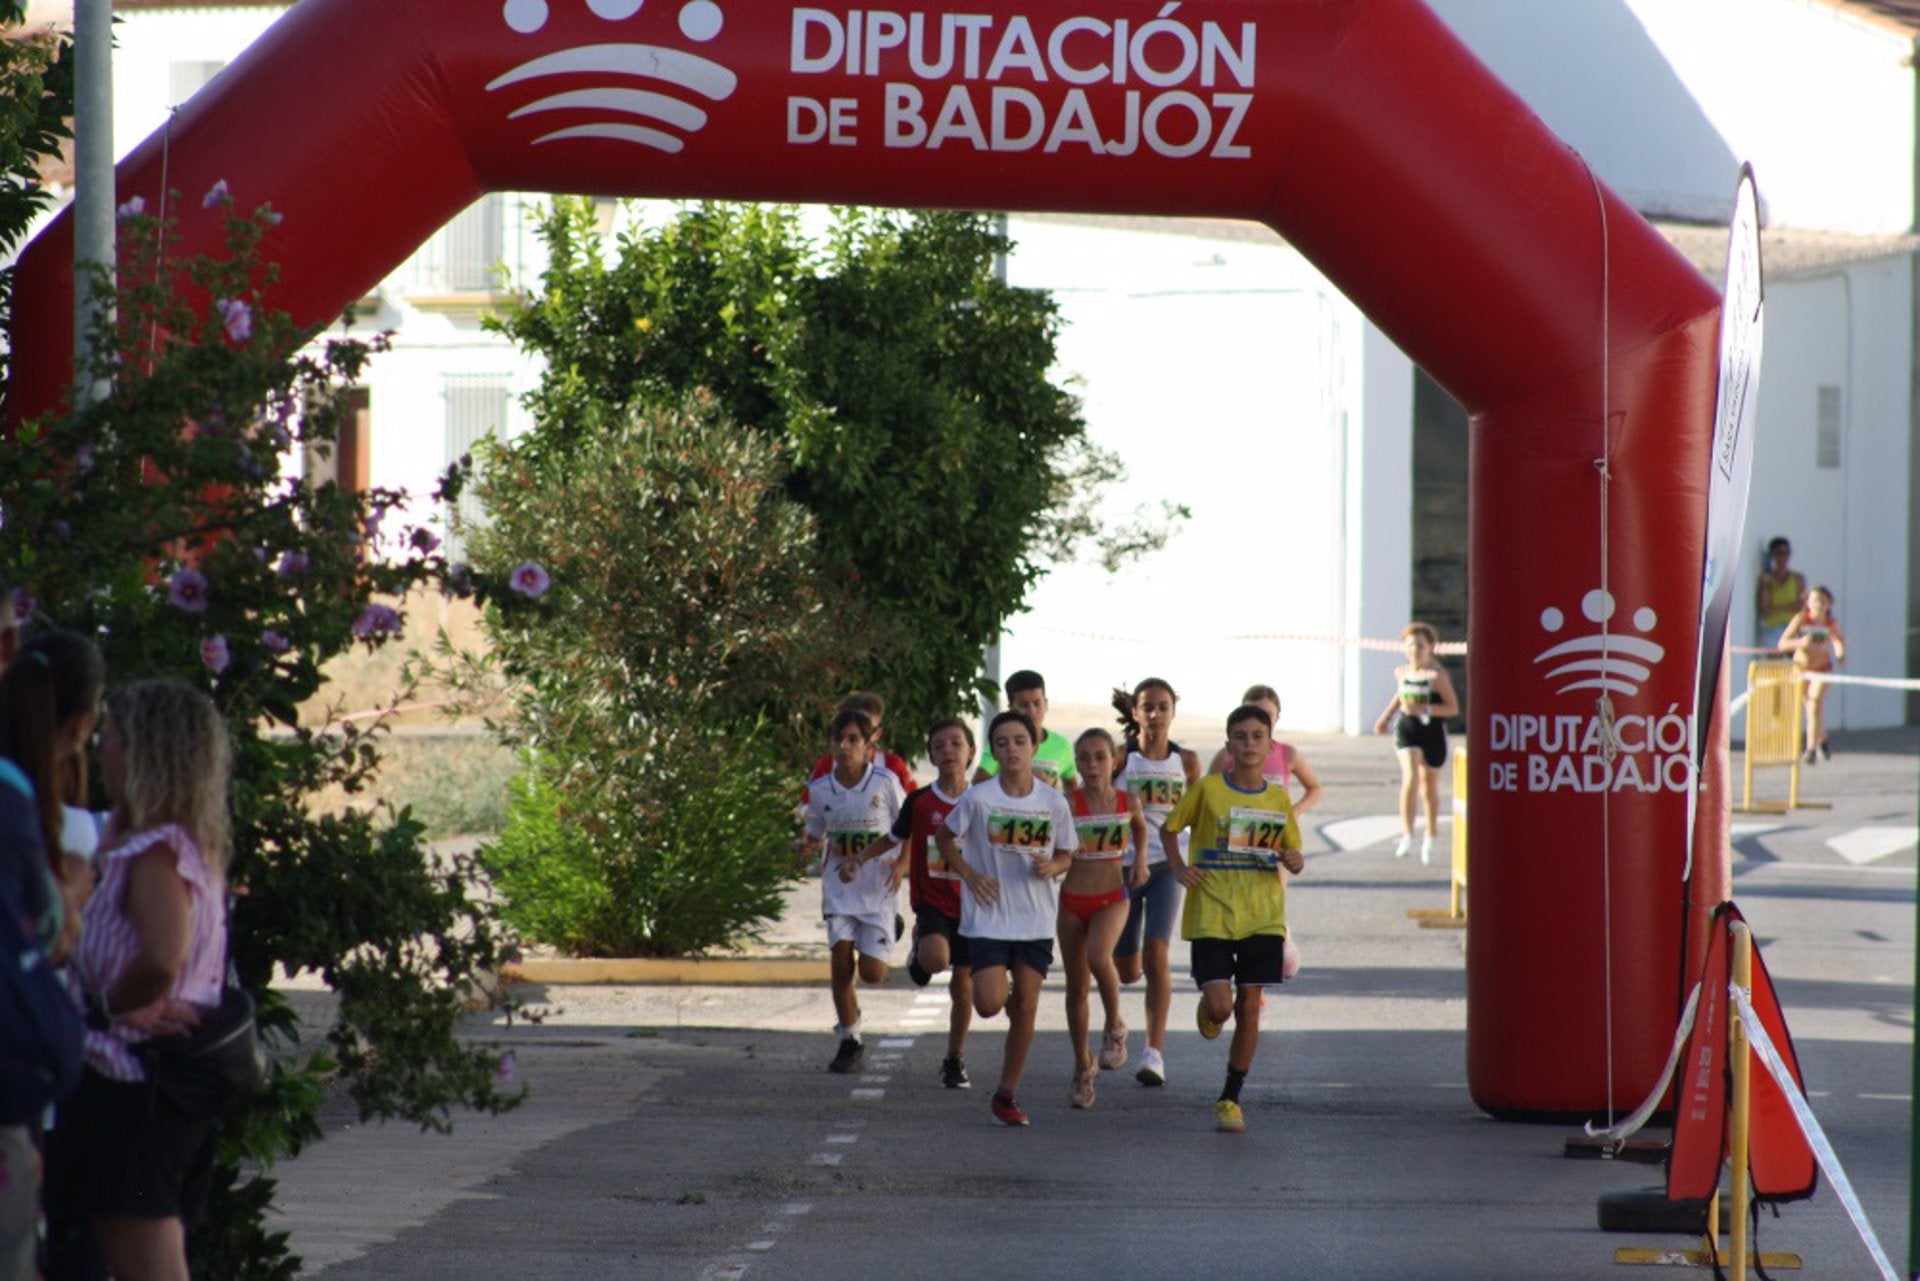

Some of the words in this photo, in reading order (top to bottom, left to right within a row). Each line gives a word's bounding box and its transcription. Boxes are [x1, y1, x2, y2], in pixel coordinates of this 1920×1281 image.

[791, 2, 1256, 88] DIPUTACIÓN
[787, 96, 858, 147] DE
[883, 83, 1254, 158] BADAJOZ
[1490, 703, 1693, 753] DIPUTACIÓ
[1489, 763, 1518, 791] DE
[1528, 754, 1708, 793] BADAJO
[1141, 778, 1183, 804] 135
[1003, 818, 1050, 844] 134
[1092, 825, 1123, 850] 74
[1244, 820, 1285, 848] 127
